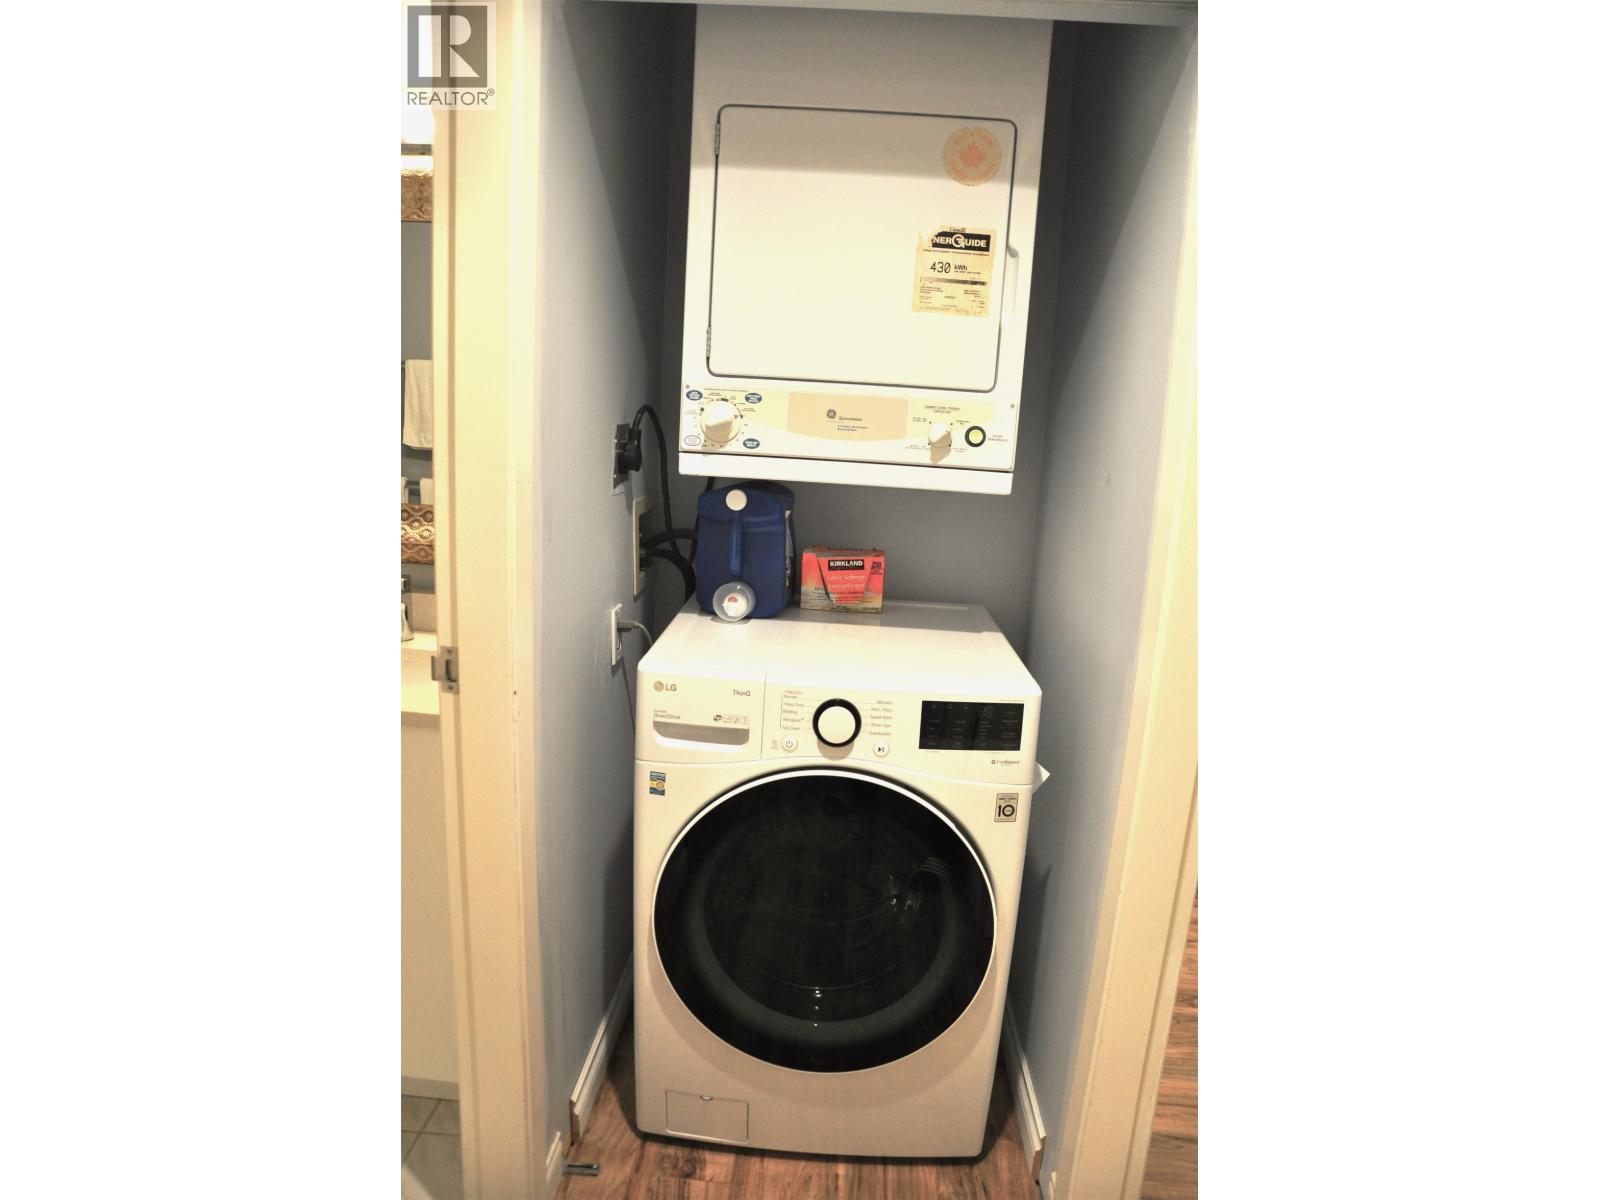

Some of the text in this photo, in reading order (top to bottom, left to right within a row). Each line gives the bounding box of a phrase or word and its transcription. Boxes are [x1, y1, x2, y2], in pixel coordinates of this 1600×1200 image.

[932, 234, 987, 248] NERGUIDE
[930, 261, 951, 274] 430
[665, 683, 677, 692] LG
[732, 689, 751, 697] ThinQ
[998, 804, 1015, 817] 10
